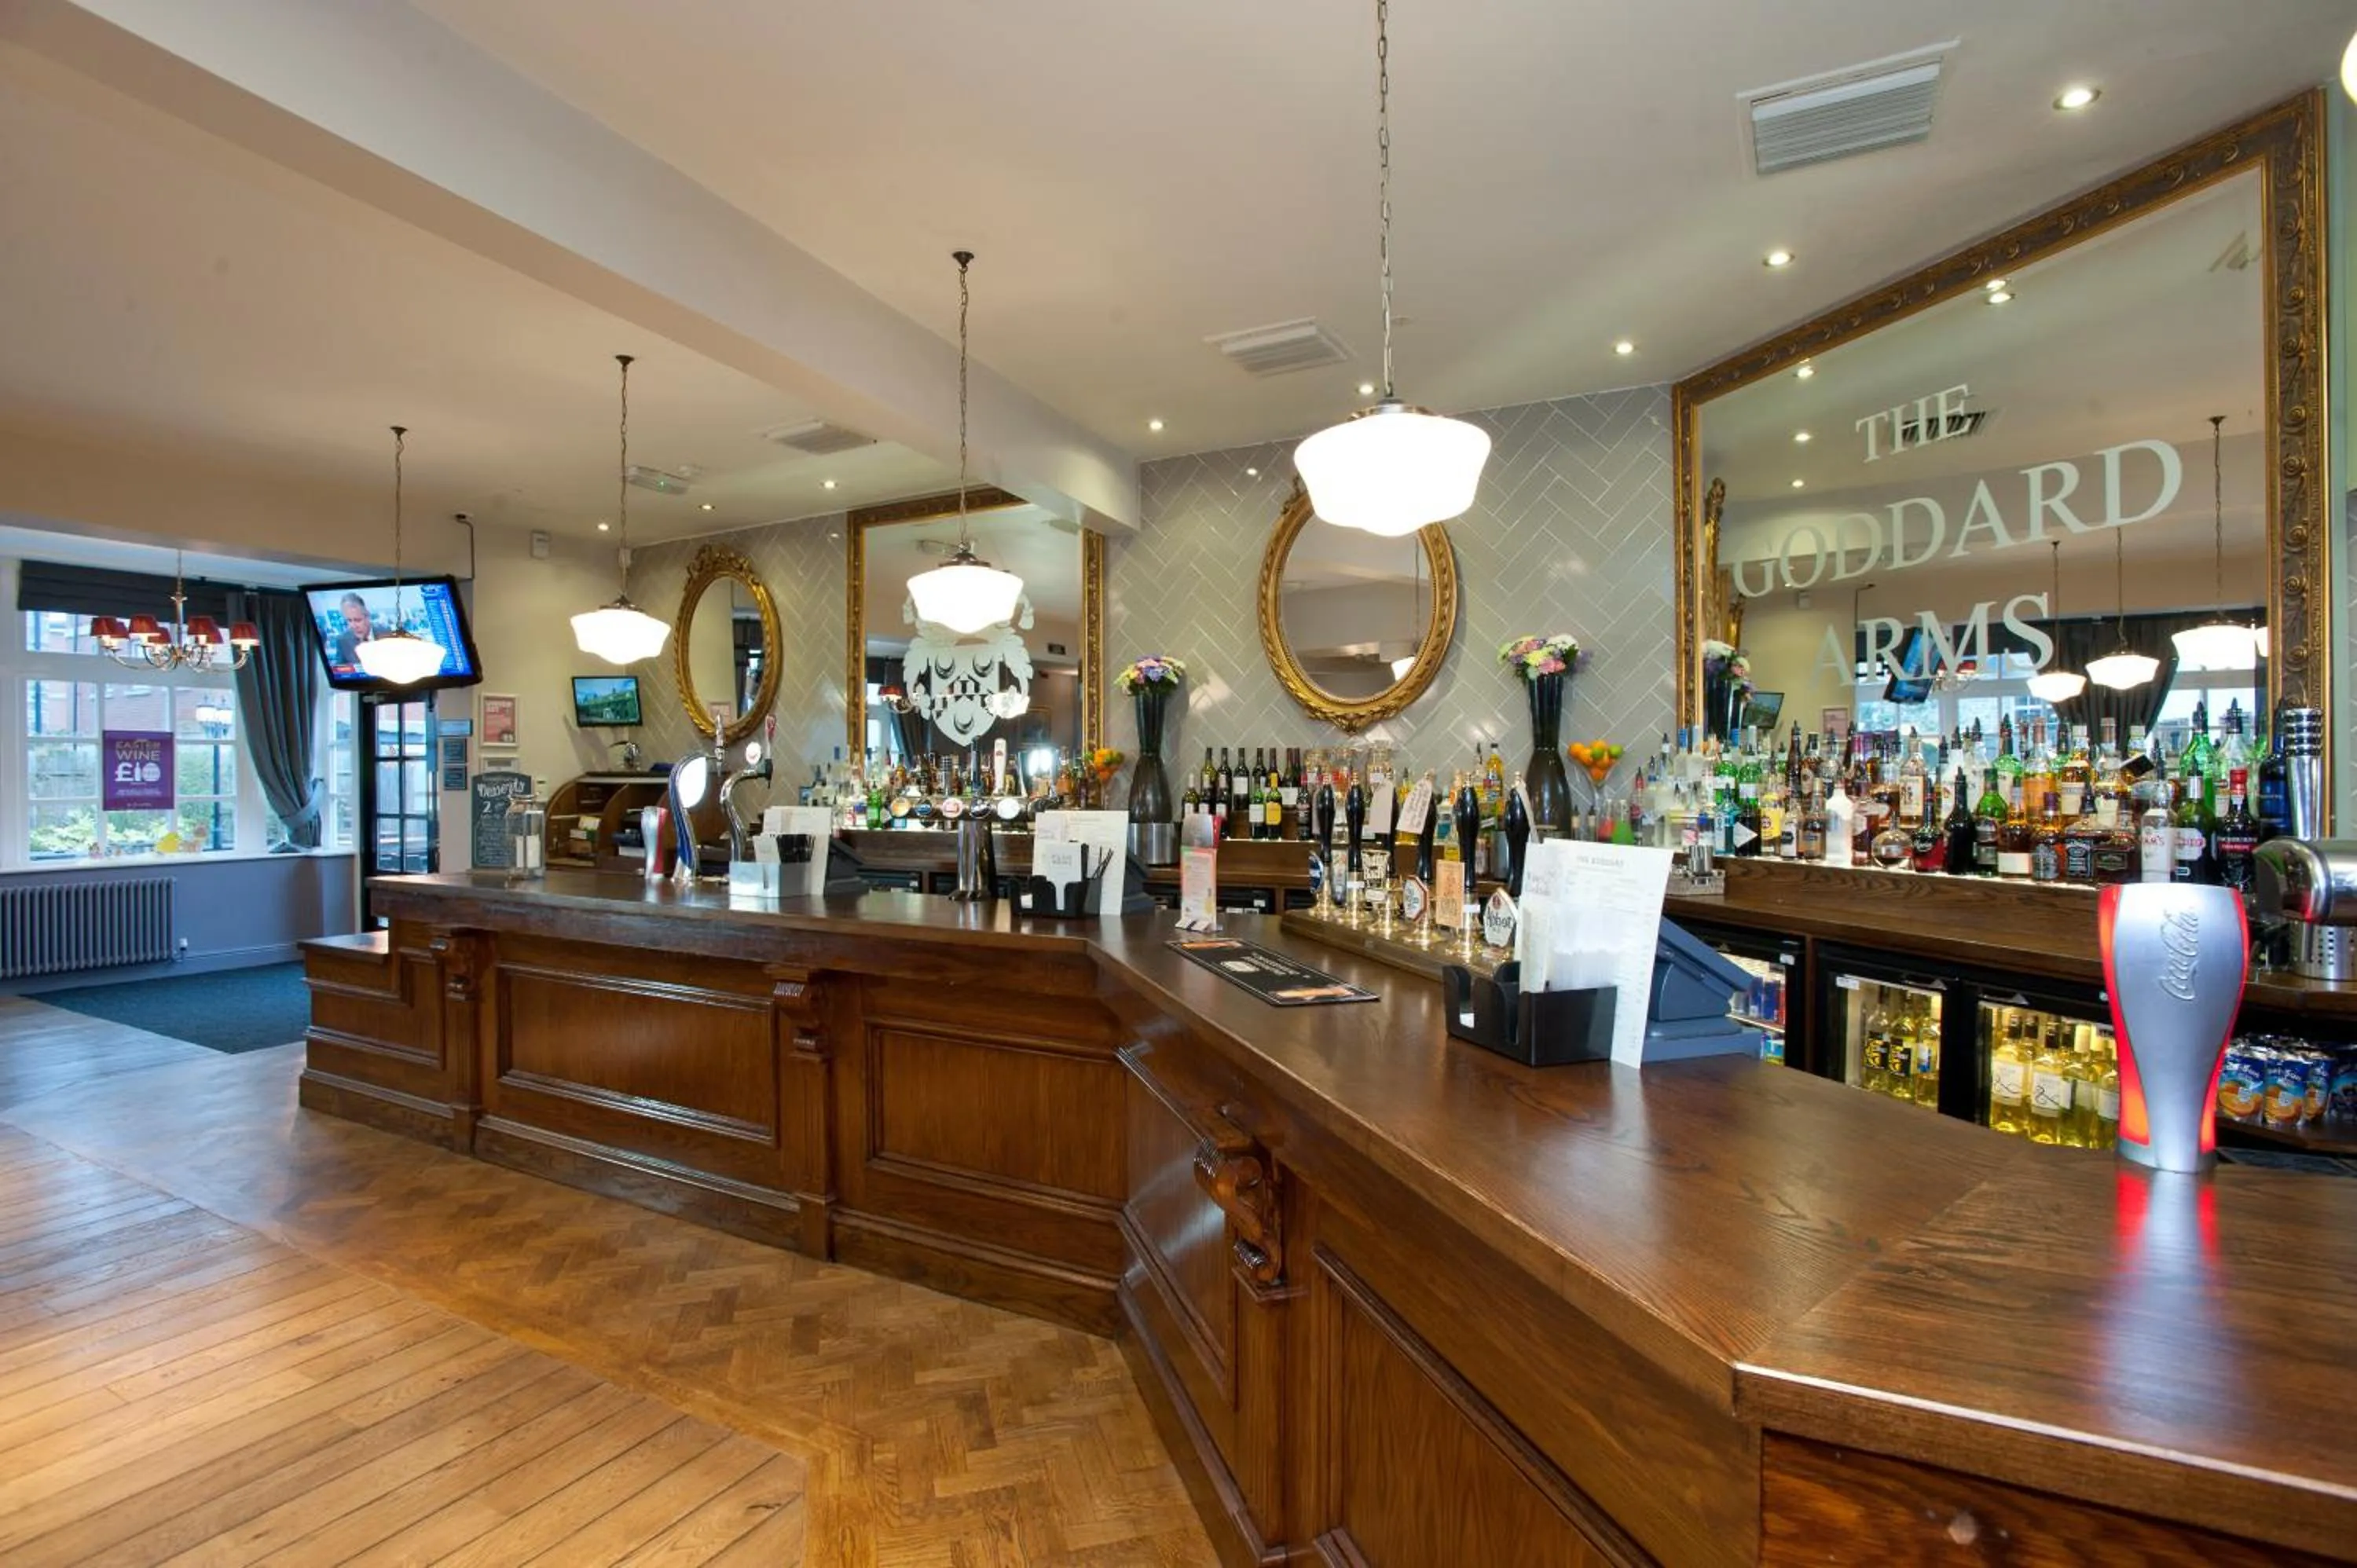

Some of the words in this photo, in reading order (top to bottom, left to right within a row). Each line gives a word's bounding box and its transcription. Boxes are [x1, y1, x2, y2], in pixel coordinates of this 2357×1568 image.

[1855, 383, 1970, 463] THE
[1732, 438, 2183, 598] GODDARD
[1809, 592, 2055, 690] ARMS
[115, 750, 161, 761] WINE
